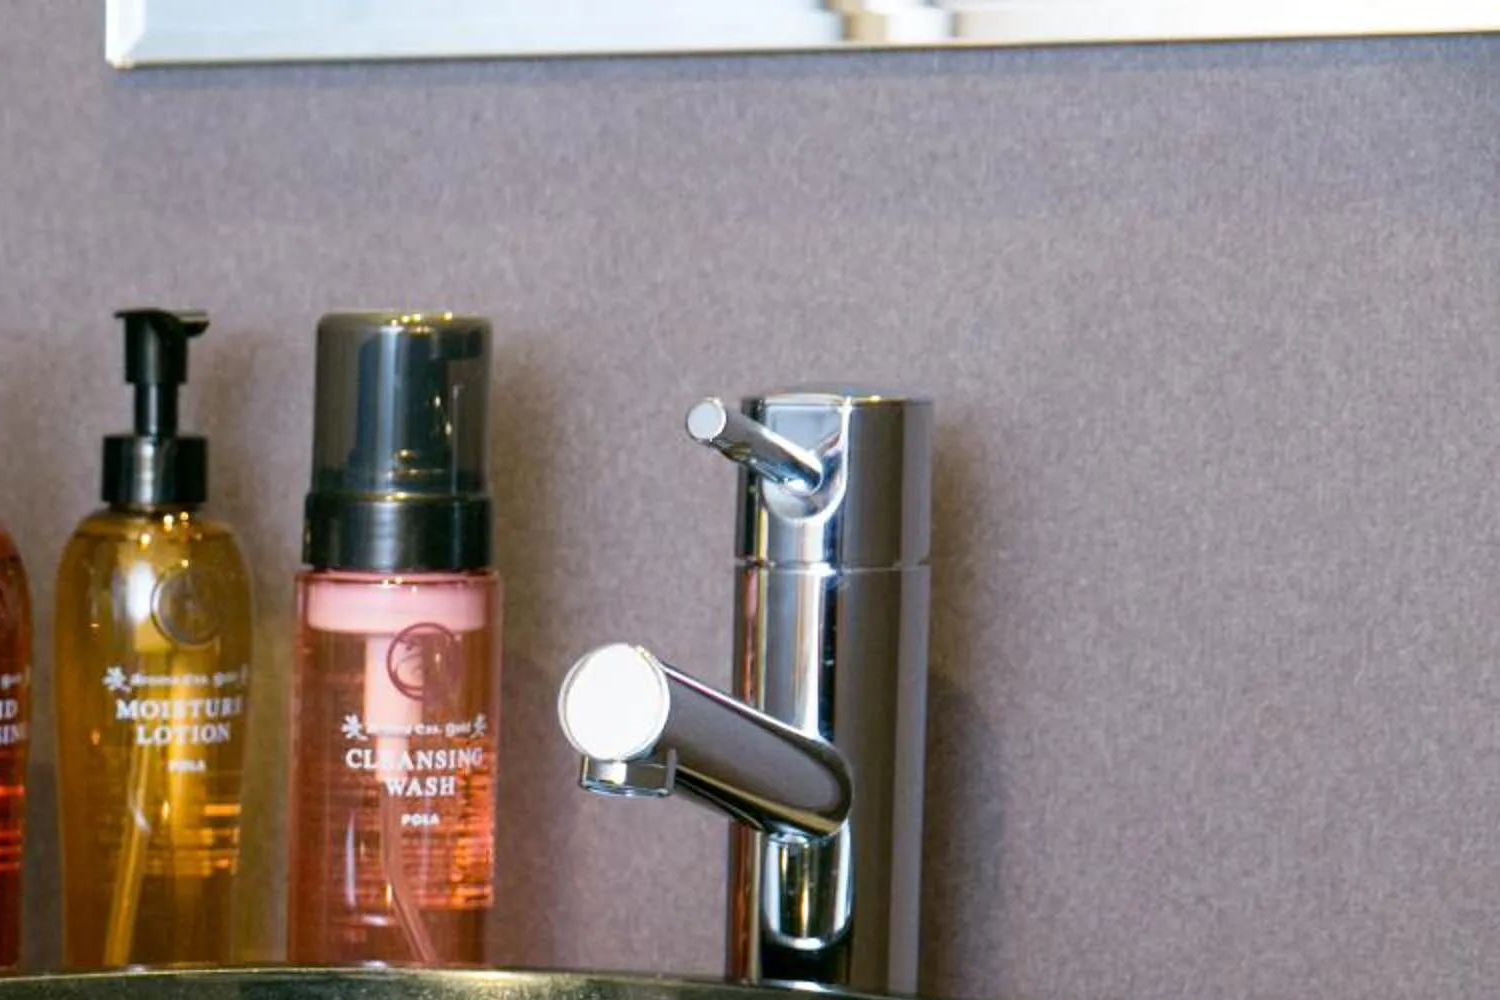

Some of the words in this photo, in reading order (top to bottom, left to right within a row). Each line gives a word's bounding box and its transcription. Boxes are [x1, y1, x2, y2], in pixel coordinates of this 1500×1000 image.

[136, 722, 231, 746] LOTION
[386, 775, 457, 797] WASH
[401, 812, 440, 827] POLA
